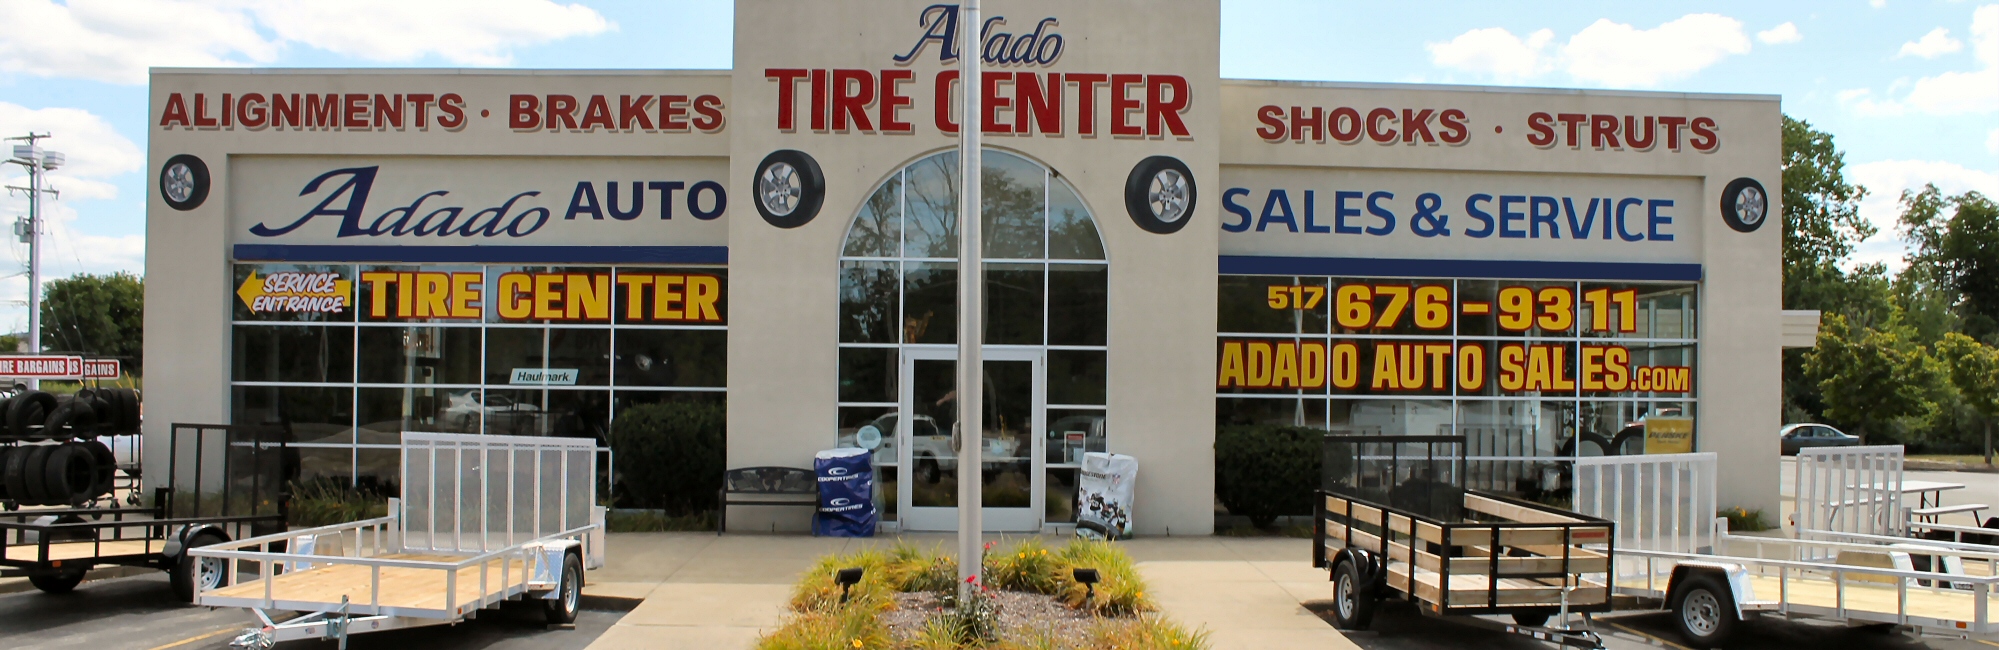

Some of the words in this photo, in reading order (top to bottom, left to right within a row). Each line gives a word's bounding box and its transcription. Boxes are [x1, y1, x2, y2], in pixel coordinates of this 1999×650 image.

[160, 92, 466, 131] ALIGNMENTS
[509, 94, 725, 132] BRAKES
[765, 69, 914, 133] TIRE
[934, 70, 1193, 139] CENTER
[1256, 105, 1470, 145] SHOCKS
[1527, 112, 1720, 152] STRUTS
[249, 165, 550, 238] Adado
[564, 180, 728, 221] AUTO
[1220, 187, 1396, 236] SALES
[1410, 192, 1450, 238] &
[1464, 193, 1675, 242] SERVICE
[251, 295, 345, 313] ENTRANCE
[262, 272, 340, 294] SERVICE
[360, 271, 483, 319] TIRE
[496, 272, 723, 322] CENTER
[1267, 284, 1326, 310] 517
[0, 361, 14, 374] IRE
[17, 361, 65, 374] BARGAINS
[84, 364, 115, 376] GAINS
[1217, 339, 1360, 390] ADADO
[1371, 342, 1486, 393] AUTO
